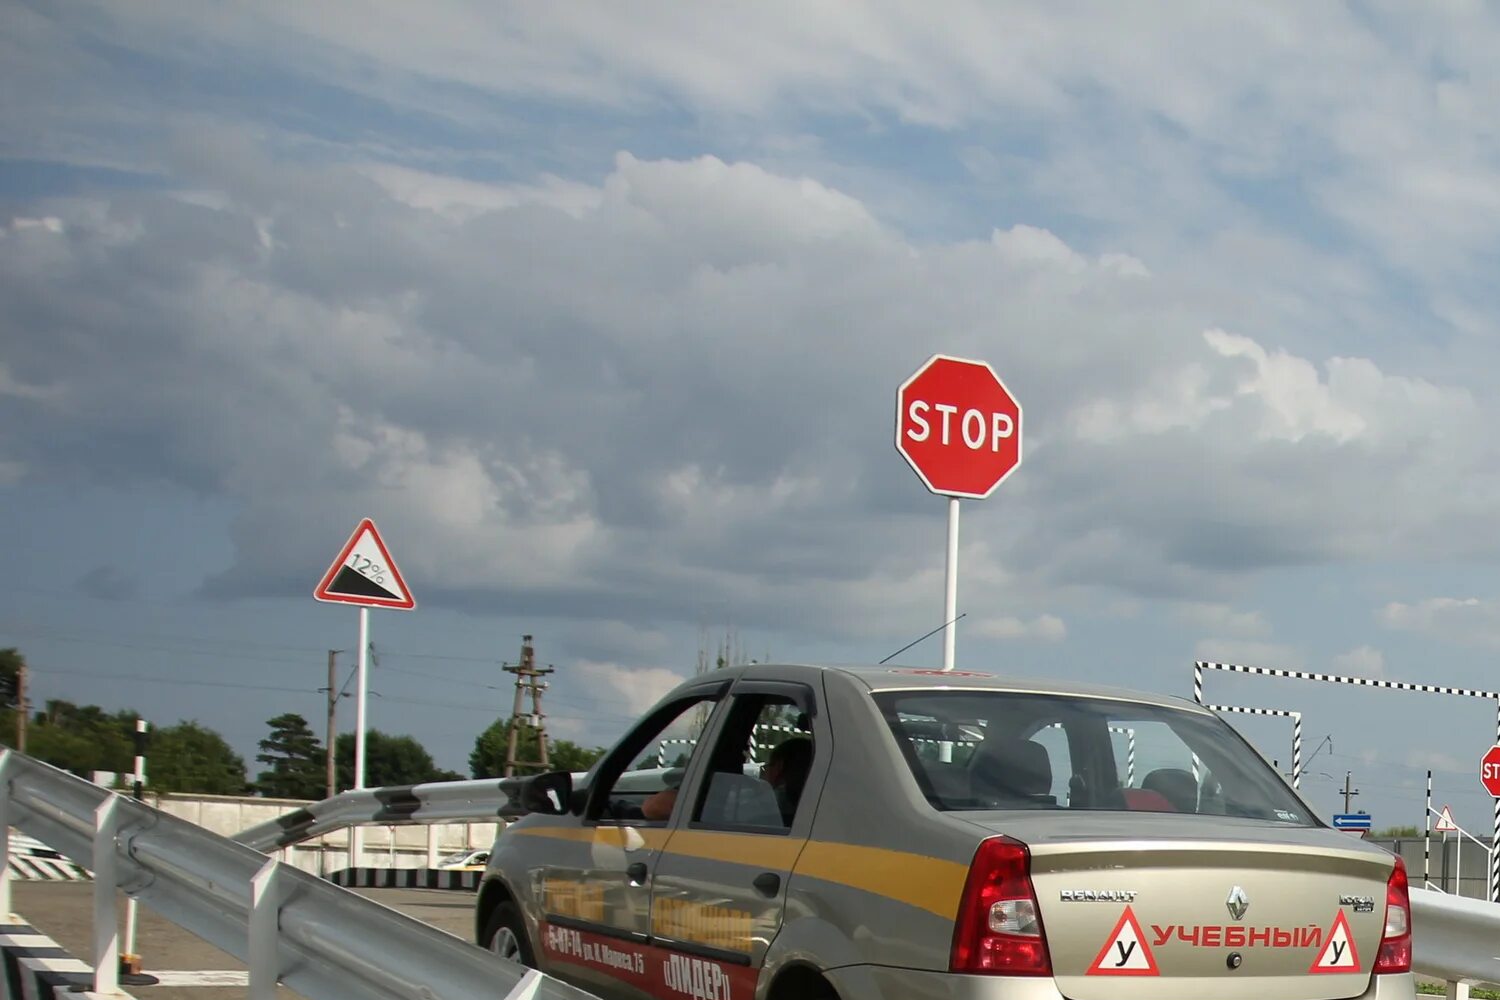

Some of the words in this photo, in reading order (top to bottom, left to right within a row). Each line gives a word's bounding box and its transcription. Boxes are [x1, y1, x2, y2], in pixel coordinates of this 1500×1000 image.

[907, 400, 1014, 452] STOP
[352, 553, 386, 584] 12%
[1060, 890, 1138, 903] RENAULT
[1151, 925, 1322, 948] УЧЕБНЫЙ
